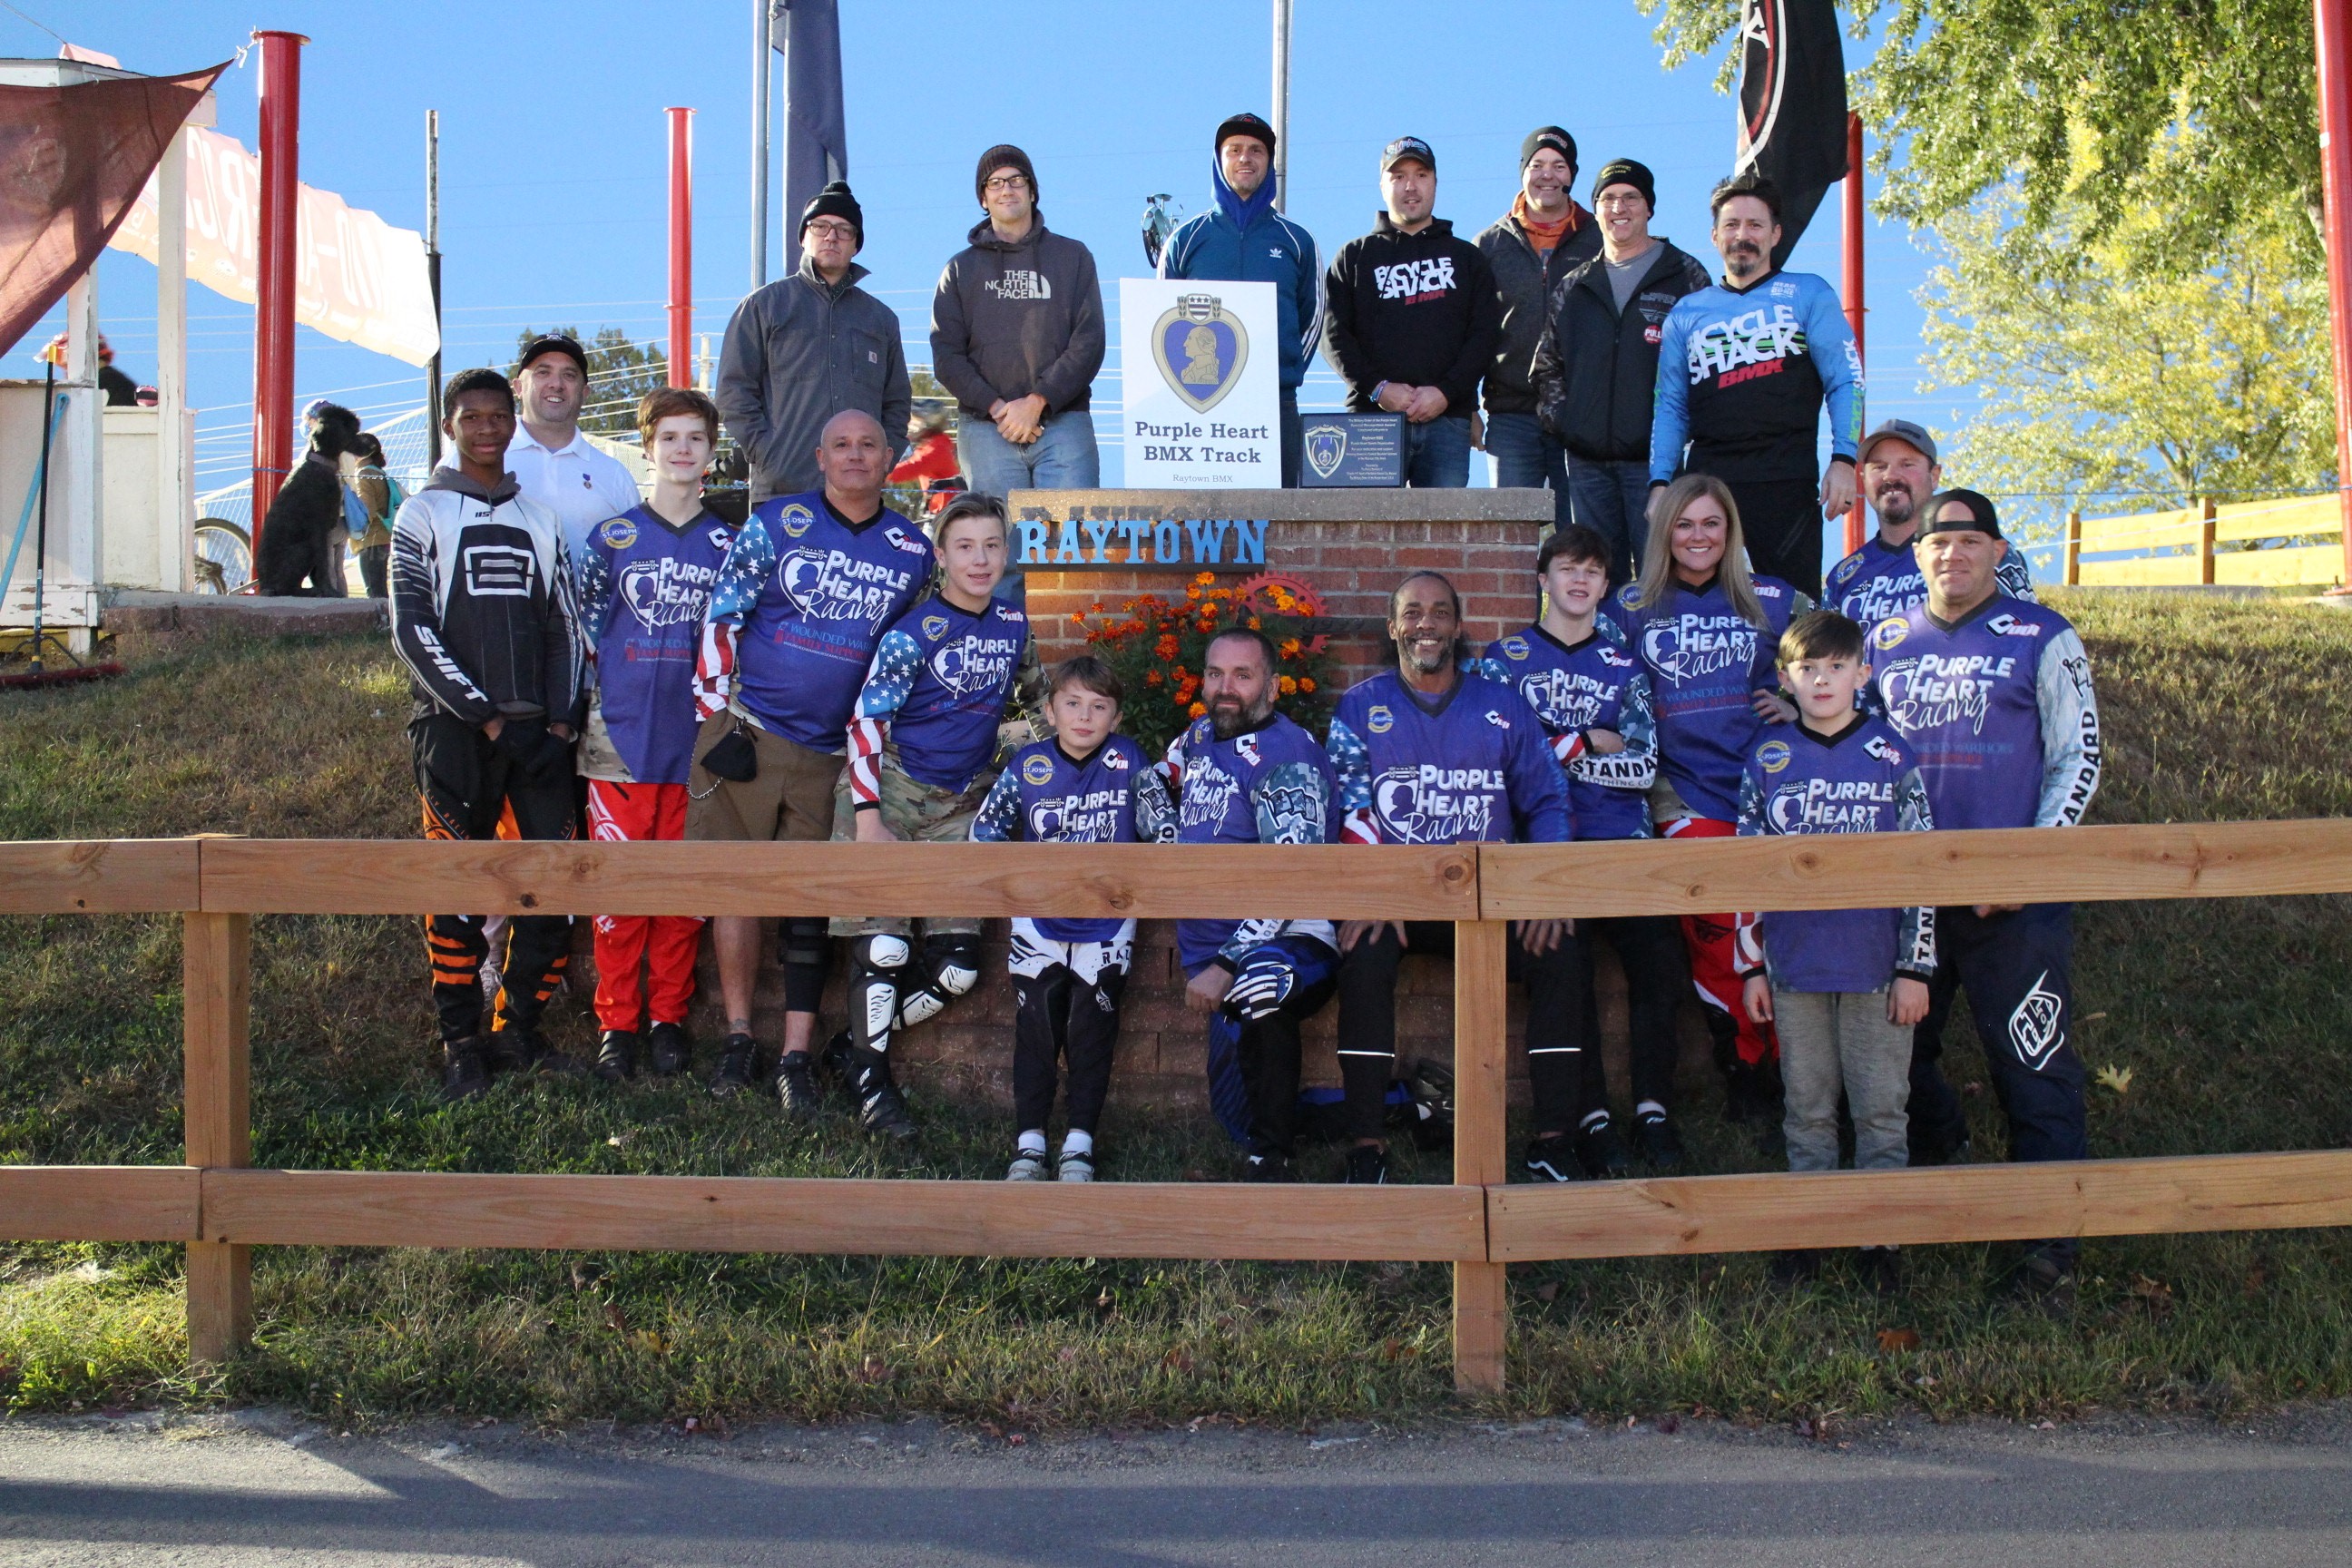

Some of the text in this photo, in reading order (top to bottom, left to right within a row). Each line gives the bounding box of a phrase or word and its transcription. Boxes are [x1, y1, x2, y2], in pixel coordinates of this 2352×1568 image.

[1004, 270, 1029, 279] THE
[1377, 268, 1457, 299] SHACK
[998, 289, 1028, 299] FACE
[1405, 289, 1446, 306] BMX
[1688, 305, 1794, 357] BICYCLE
[1688, 322, 1803, 386] SHACK
[1718, 358, 1785, 390] BMX
[1135, 421, 1269, 441] Purple Heart
[1143, 446, 1262, 464] BMX Track
[1172, 474, 1234, 485] Raytown BMX
[1016, 519, 1270, 564] RAYTOWN
[659, 556, 718, 588] PURPL
[824, 549, 912, 593] PURPLE
[818, 570, 897, 608] HEART
[1867, 572, 1929, 599] PURP
[802, 588, 891, 637] Racing
[1680, 613, 1759, 633] PURPL
[789, 622, 847, 646] WOUNDED
[1679, 631, 1759, 653] HEART
[414, 624, 489, 702] SHIFT
[1668, 639, 1759, 689] Racing
[1915, 653, 2017, 680] PURPLE
[1551, 668, 1620, 702] PURPLE
[1907, 677, 1995, 704] HEART
[1897, 691, 1992, 738] Racing
[1419, 763, 1506, 791] PURPLE
[1573, 757, 1658, 779] STANDA
[2055, 710, 2102, 827] ANDARD
[1063, 789, 1129, 816] PURPLE
[1416, 789, 1496, 818] HEART
[1807, 778, 1894, 802] PURPLE
[1061, 808, 1118, 832] HEART
[1402, 807, 1494, 845] Racing
[1802, 800, 1882, 825] HEART
